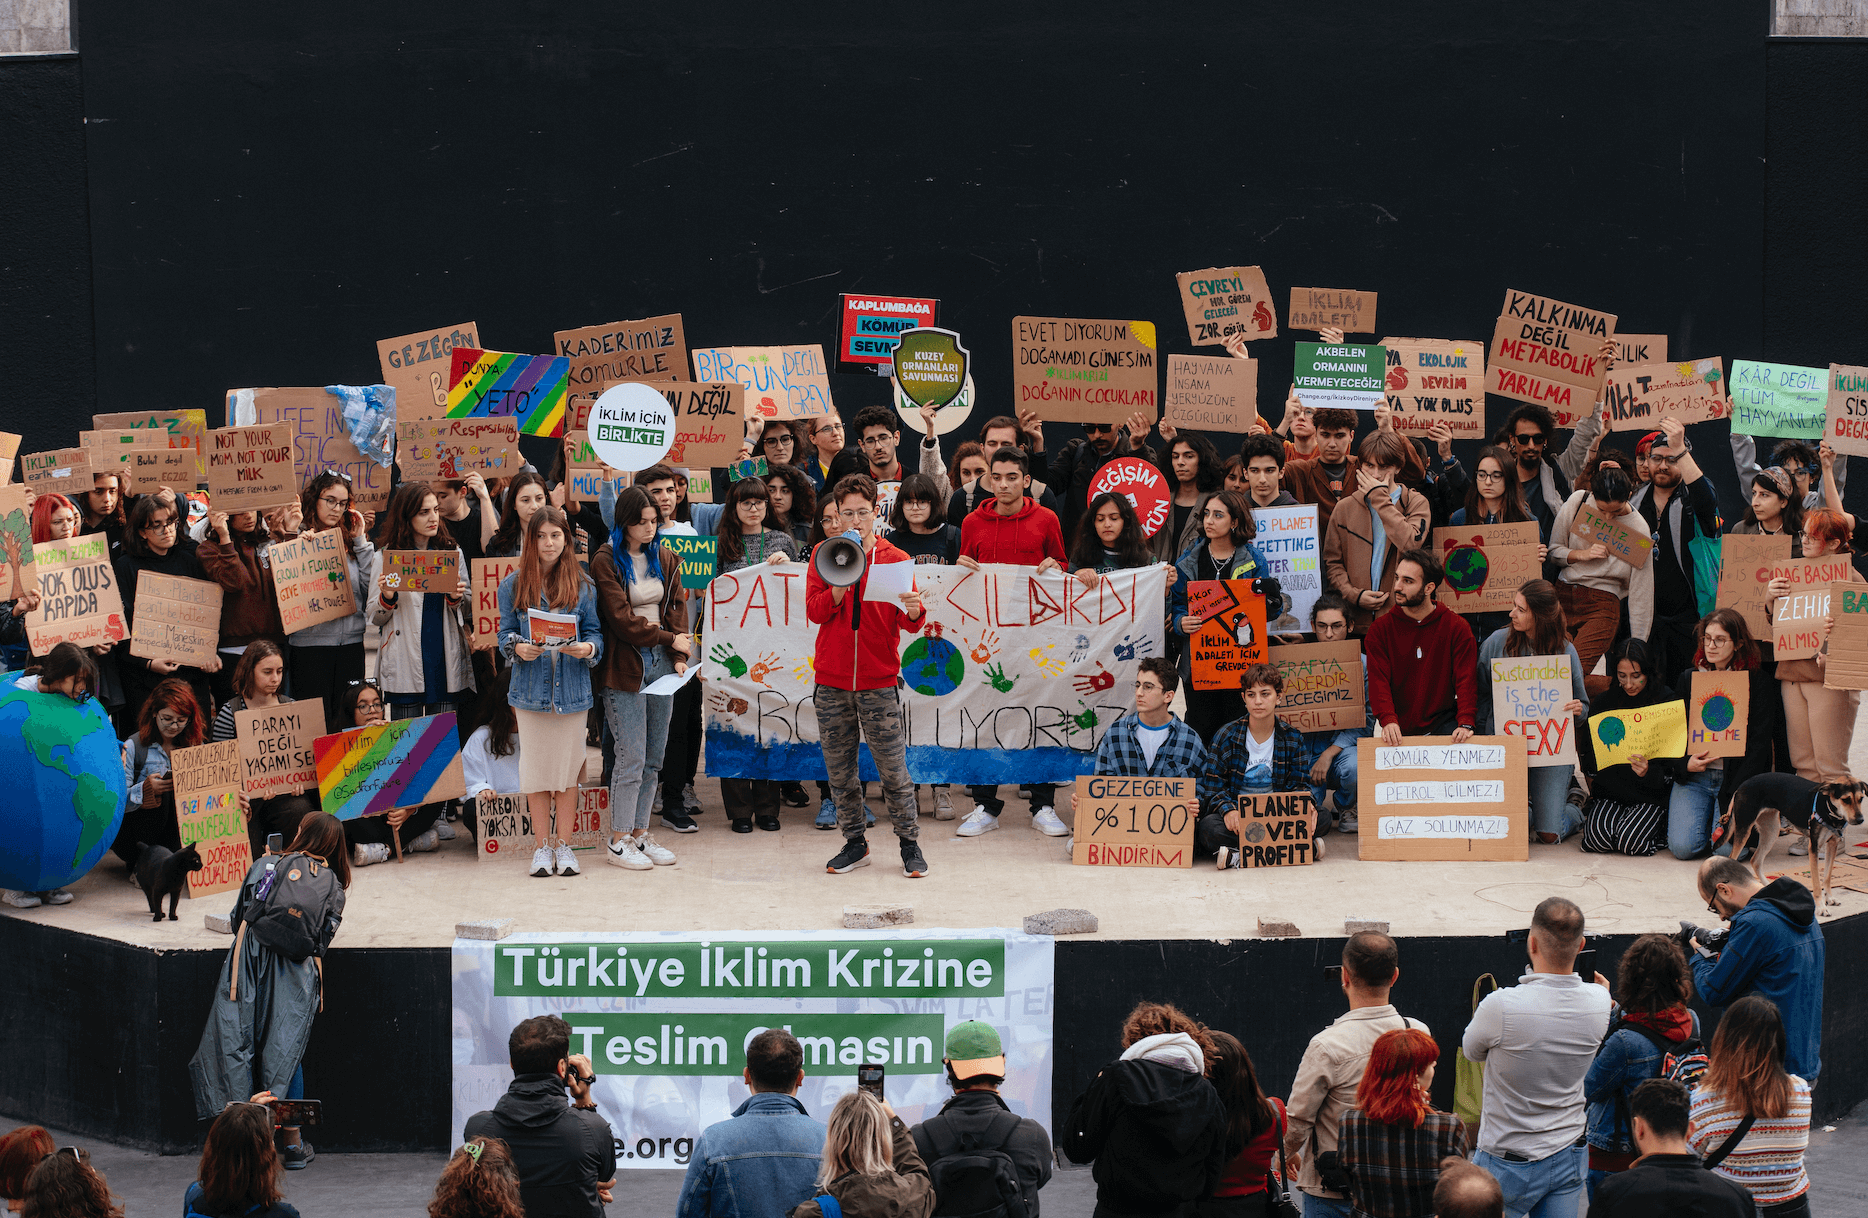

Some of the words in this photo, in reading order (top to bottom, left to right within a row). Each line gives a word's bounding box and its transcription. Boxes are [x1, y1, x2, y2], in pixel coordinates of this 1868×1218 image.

[848, 299, 931, 315] KAPLUMBAĞA
[1308, 290, 1363, 312] İKLİM
[1508, 292, 1606, 337] KALKINMA
[861, 318, 915, 333] KÖMÜR
[1019, 321, 1058, 342] EVET
[1064, 321, 1127, 342] DİYORUM
[1194, 322, 1222, 341] ZOR
[1520, 323, 1570, 350] DEĞİL
[388, 330, 475, 368] GEZEGEN
[914, 351, 945, 361] KUZEY
[1089, 350, 1152, 369] GÜNEŞİM
[1315, 346, 1366, 358] AKBELEN
[1386, 349, 1402, 366] YA
[1499, 338, 1598, 378] METABOLİK
[783, 349, 827, 377] DEĞİL
[901, 361, 958, 373] ORMANLARI
[1174, 360, 1233, 376] HAYVANA
[1312, 361, 1368, 373] ORMANINI
[902, 373, 958, 383] SAVUNMASI
[1174, 376, 1211, 391] İNSANA
[1295, 375, 1382, 389] VERMEYECEĞİZ!
[1421, 373, 1467, 390] DEVRİM
[1498, 368, 1571, 406] YARILMA
[1780, 370, 1820, 390] DEĞİL
[687, 384, 736, 420] DEĞİL
[787, 384, 830, 416] GREV
[1022, 381, 1081, 402] DOĞANIN
[1084, 388, 1154, 406] ÇOCUKLARI
[1386, 395, 1404, 412] YA
[1414, 396, 1437, 412] YOK
[1652, 394, 1712, 413] Verilsin
[1738, 387, 1774, 406] TÜM
[326, 407, 344, 435] IN
[599, 405, 636, 422] İKLİM
[639, 409, 667, 427] İÇİN
[215, 431, 238, 449] NOT
[244, 430, 272, 448] YOUR
[429, 426, 448, 440] our
[598, 425, 663, 445] BİRLİKTE
[237, 450, 256, 464] NOT
[260, 446, 290, 463] YOUR
[410, 445, 432, 461] to
[469, 445, 495, 456] our
[1271, 516, 1315, 532] PLANET
[271, 543, 298, 565] PLANT
[300, 539, 308, 557] A
[309, 534, 336, 552] TREE
[1257, 536, 1315, 553] GETTING
[276, 566, 299, 584] GROW
[301, 563, 307, 576] A
[309, 555, 343, 574] FLOWER
[389, 552, 426, 565] İKLİM
[433, 552, 455, 567] İÇİN
[1491, 554, 1530, 577] %35
[37, 571, 67, 597] YOK
[72, 564, 111, 590] OLUŞ
[407, 578, 429, 590] GEÇ
[1774, 564, 1800, 583] DAĞ
[140, 575, 161, 595] This
[172, 580, 207, 603] Planet
[280, 583, 299, 601] GIVE
[44, 592, 98, 622] KAPIDA
[138, 601, 163, 614] can't
[167, 605, 177, 619] be
[179, 607, 207, 623] hotter
[282, 605, 307, 626] EARTH
[1777, 593, 1831, 622] ZEHİR
[1201, 634, 1230, 648] İKLİM
[1240, 648, 1260, 660] İÇİN
[1492, 658, 1571, 683] Sustainable
[1505, 685, 1520, 703] is
[1527, 680, 1560, 702] the
[1515, 702, 1553, 718] new
[252, 714, 301, 736] PARAYI
[1725, 728, 1741, 742] ME
[258, 732, 302, 755] DEĞİL
[246, 753, 290, 778] YAŞAMI
[1383, 748, 1431, 767] KÖMÜR
[1441, 749, 1501, 766] YENMEZ!
[246, 773, 284, 793] DOĞANIN
[1088, 778, 1185, 799] GEZEGENE
[1386, 785, 1435, 801] PETROL
[1444, 782, 1499, 798] İÇİLMEZ!
[181, 795, 200, 816] BİZİ
[205, 792, 235, 811] ANCAK
[479, 796, 521, 817] KARBON
[1239, 795, 1312, 819] PLANET
[481, 815, 517, 839] YOKSA
[1091, 803, 1189, 836] %100
[1385, 819, 1414, 835] GAZ
[1424, 819, 1500, 835] SOLUNMAZ!
[206, 841, 249, 867] DOĞANIN
[1088, 842, 1183, 867] BİNDİRİM
[1242, 844, 1310, 868] PROFIT
[502, 946, 685, 997] Türkiye
[700, 941, 811, 988] İklim
[828, 946, 993, 988] Krizine
[571, 1024, 728, 1066] Teslim
